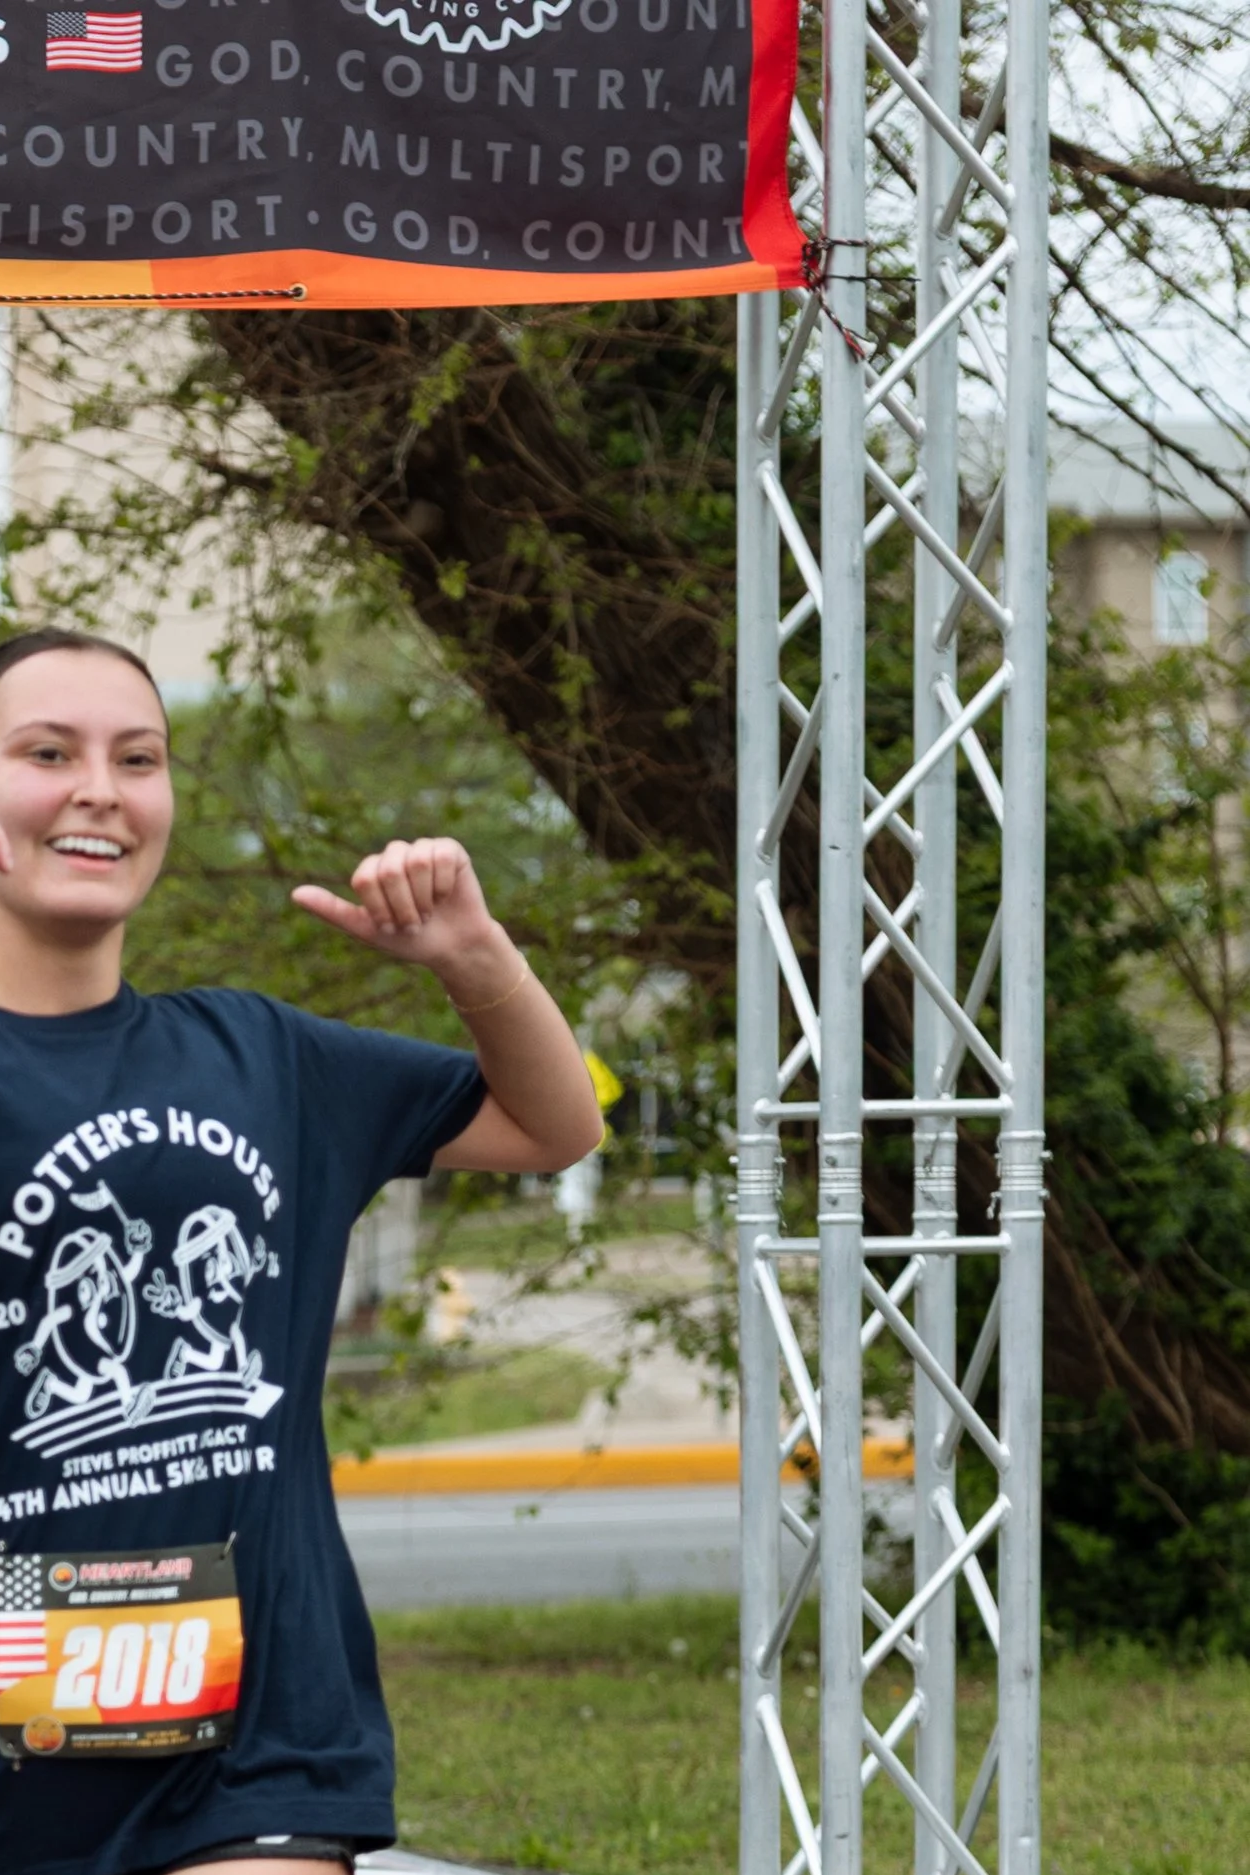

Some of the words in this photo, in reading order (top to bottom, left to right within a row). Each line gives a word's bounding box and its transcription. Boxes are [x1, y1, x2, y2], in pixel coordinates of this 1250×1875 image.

[156, 40, 310, 88] GOD,
[337, 49, 671, 112] COUNTRY,
[699, 65, 737, 108] M
[343, 202, 491, 260] GOD,
[522, 216, 744, 263] COUNT
[166, 1105, 281, 1222] HOUSE
[52, 1468, 163, 1511] ANNUAL
[62, 1450, 115, 1479] STEVE
[52, 1617, 211, 1710] 2018
